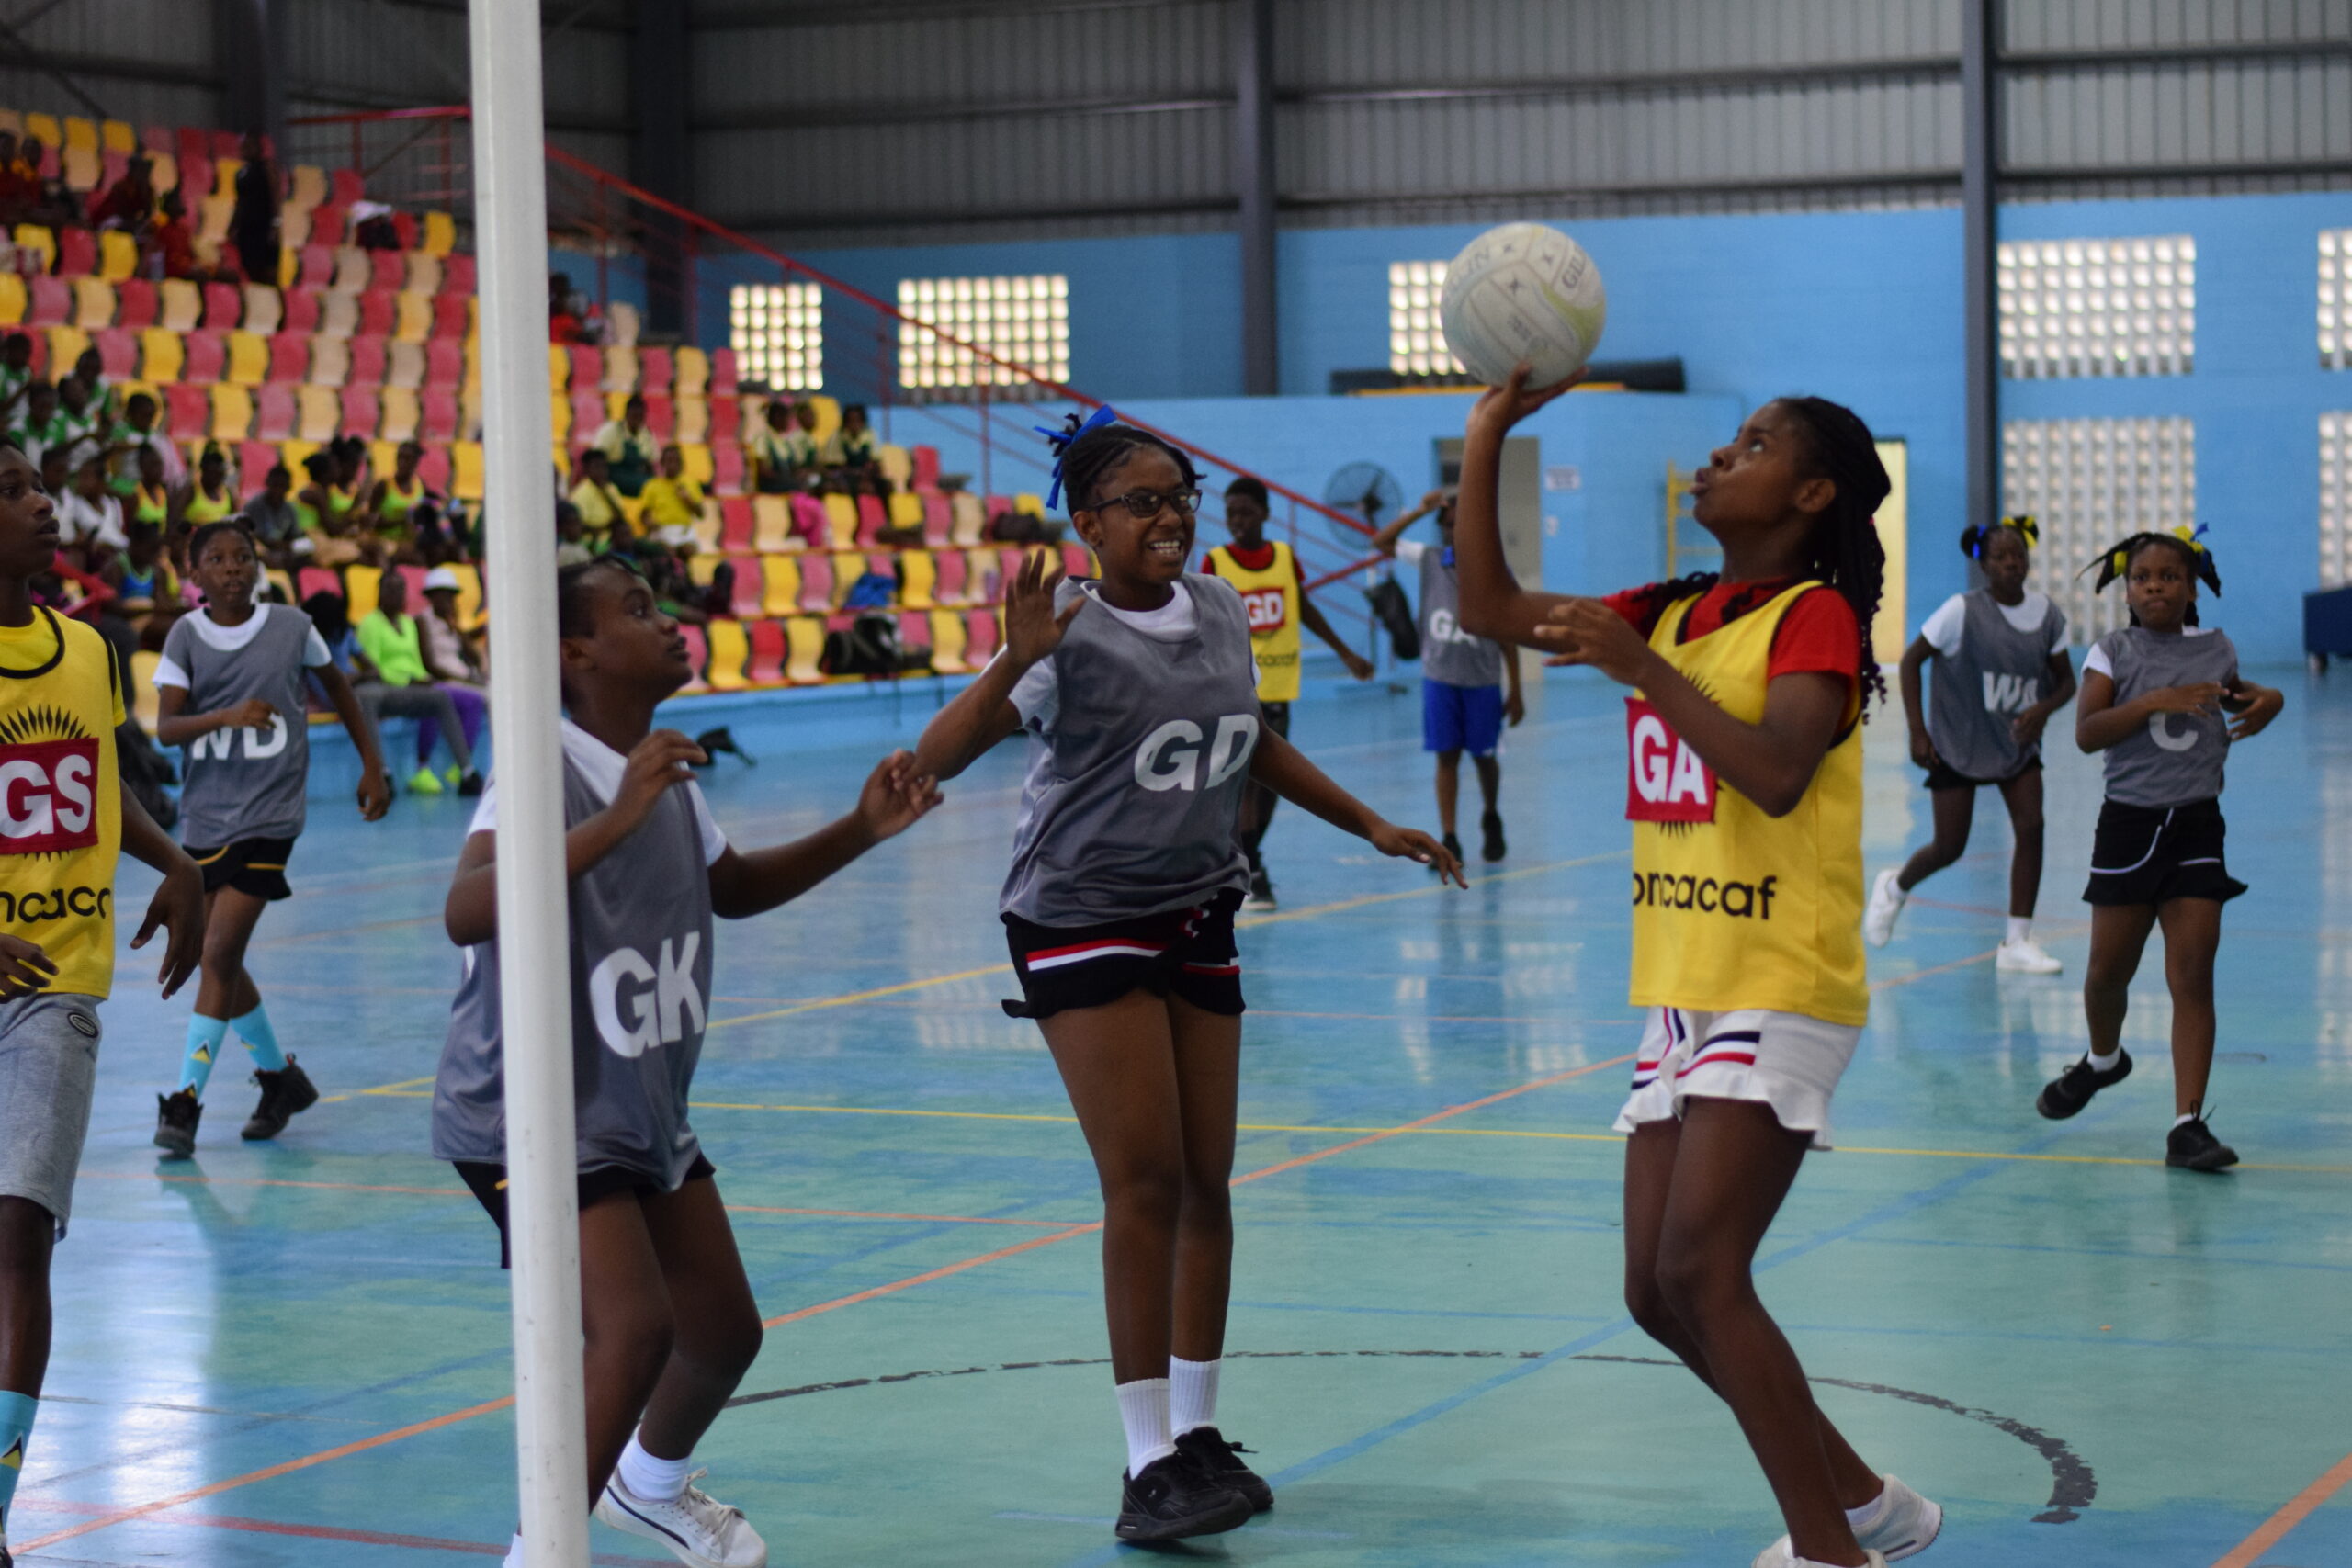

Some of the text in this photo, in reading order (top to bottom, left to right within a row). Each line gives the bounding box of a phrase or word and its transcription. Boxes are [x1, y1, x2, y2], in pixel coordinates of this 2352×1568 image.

[1244, 592, 1283, 626] GD
[1983, 671, 2038, 713] WA
[1134, 713, 1260, 792] GD
[1633, 715, 1708, 805] GA
[0, 753, 92, 839] GS
[589, 930, 706, 1058] GK
